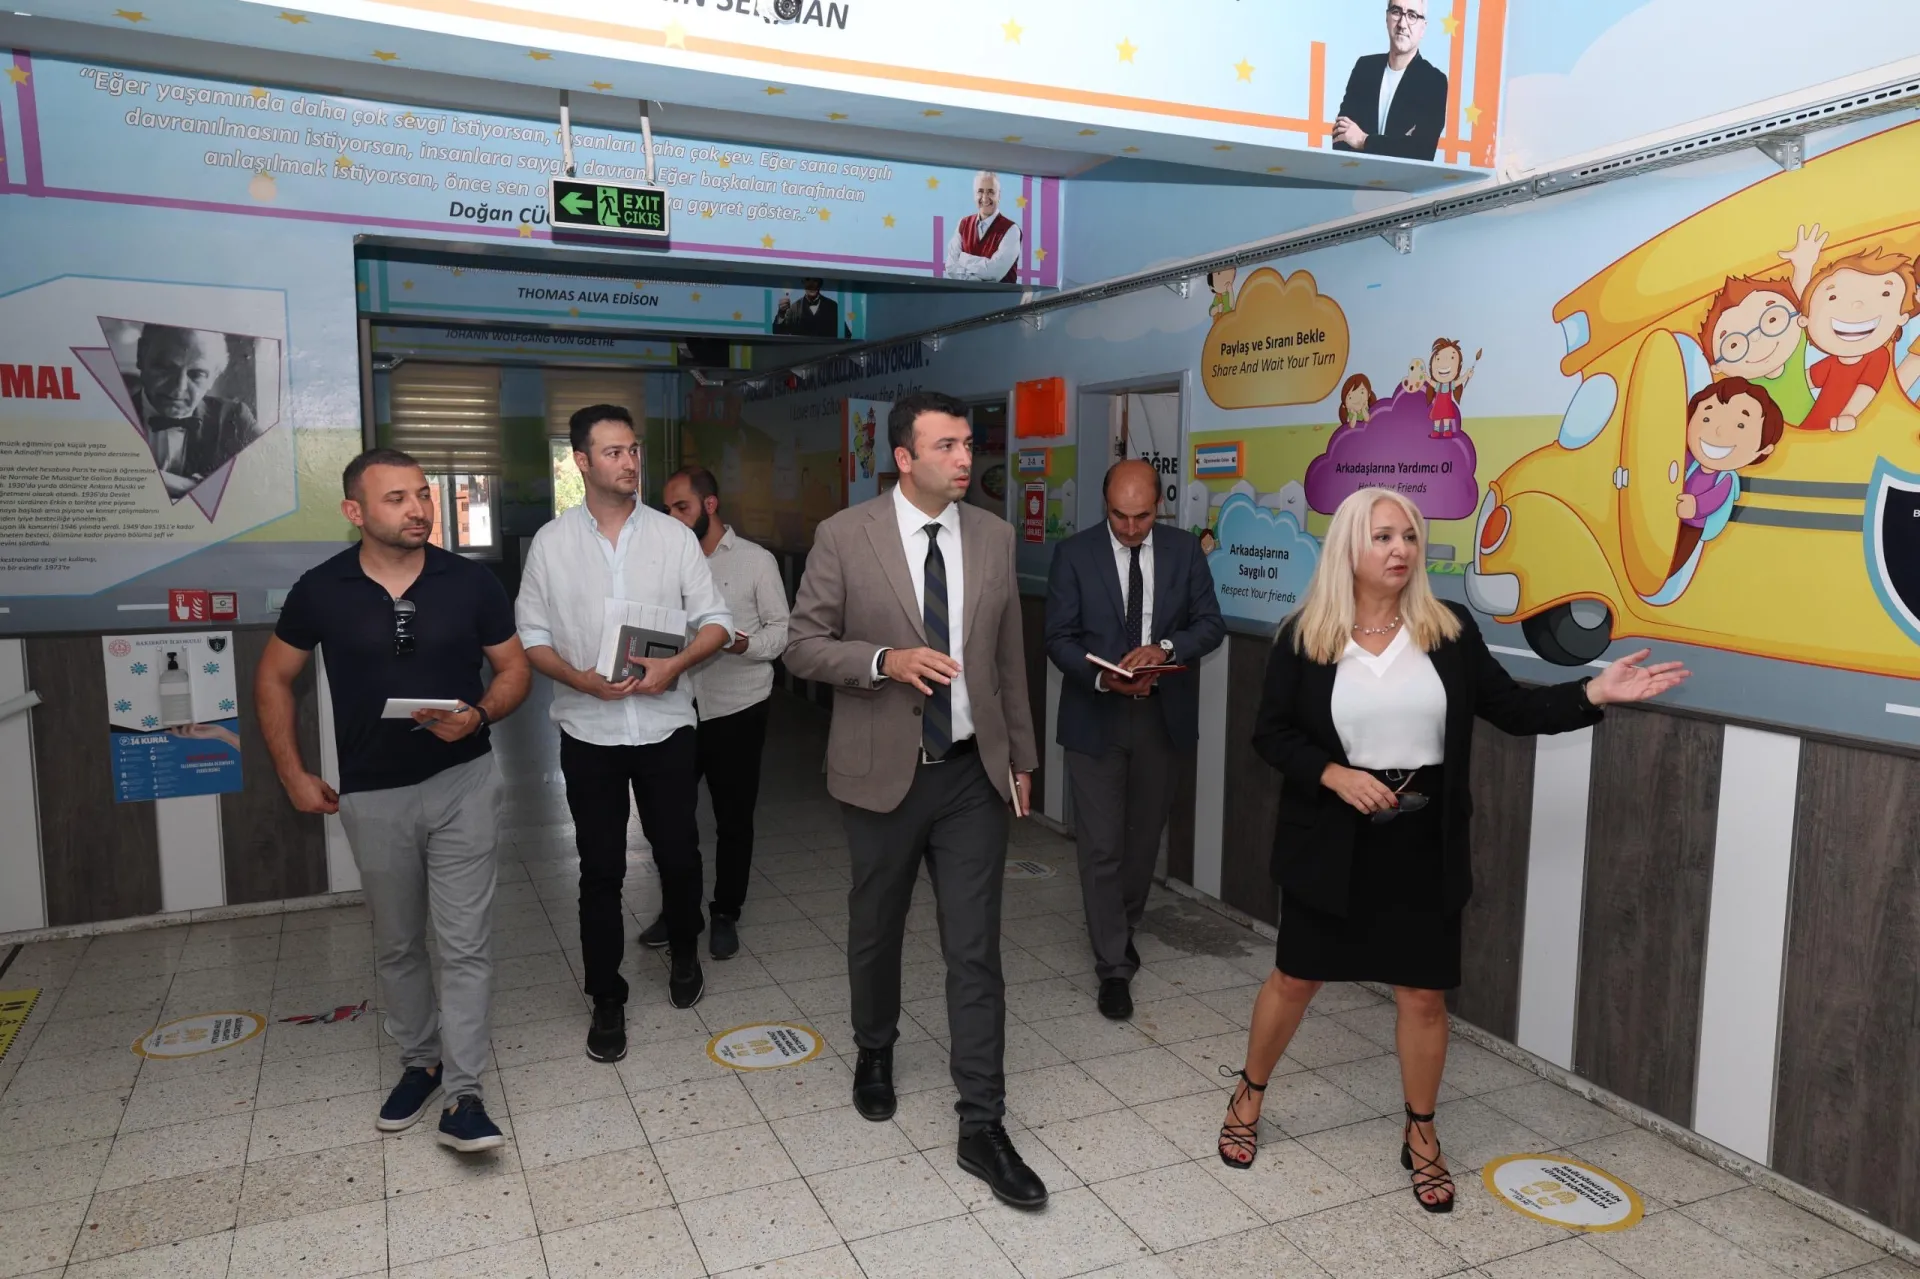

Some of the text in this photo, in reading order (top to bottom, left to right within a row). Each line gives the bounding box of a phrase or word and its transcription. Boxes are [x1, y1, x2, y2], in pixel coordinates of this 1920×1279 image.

[156, 82, 285, 112] yaşamında
[290, 98, 346, 121] daha
[351, 108, 388, 127] çok
[393, 114, 447, 135] sevgi
[451, 117, 551, 146] istiyorsan,
[556, 128, 636, 153] isanları
[690, 146, 719, 163] çok
[723, 152, 754, 166] sev.
[759, 151, 796, 172] Eğer
[799, 160, 838, 175] sana
[841, 163, 893, 182] saygılı
[125, 107, 299, 145] davranılmasını
[305, 128, 413, 160] istiyorsan,
[419, 141, 512, 167] insanlara
[657, 167, 696, 187] Eğer
[700, 170, 777, 194] başkaları
[781, 180, 866, 203] tarafından
[204, 149, 328, 178] anlaşılmak
[333, 161, 439, 191] istiyorsan,
[445, 173, 491, 193] önce
[496, 181, 530, 196] sen
[449, 201, 513, 223] Doğan
[623, 193, 661, 212] EXIT
[687, 200, 743, 217] gayret
[623, 211, 661, 228] ÇIKIŞ
[517, 287, 659, 307] THOMAS ALVA EDİSON
[444, 329, 616, 347] JOHANN WOLFGANG VON GOETHE
[1220, 328, 1325, 357] Paylaş ve Sıranı Bekle
[1212, 351, 1336, 378] Share And Wait Your Turn
[1335, 461, 1453, 476] Arkadaşlarına Yardımcı Ol
[1397, 482, 1427, 493] Friends
[1230, 543, 1289, 561] Arkadaşlarına
[1238, 563, 1278, 580] Saygılı Ol
[1221, 583, 1297, 604] Respect Your friends
